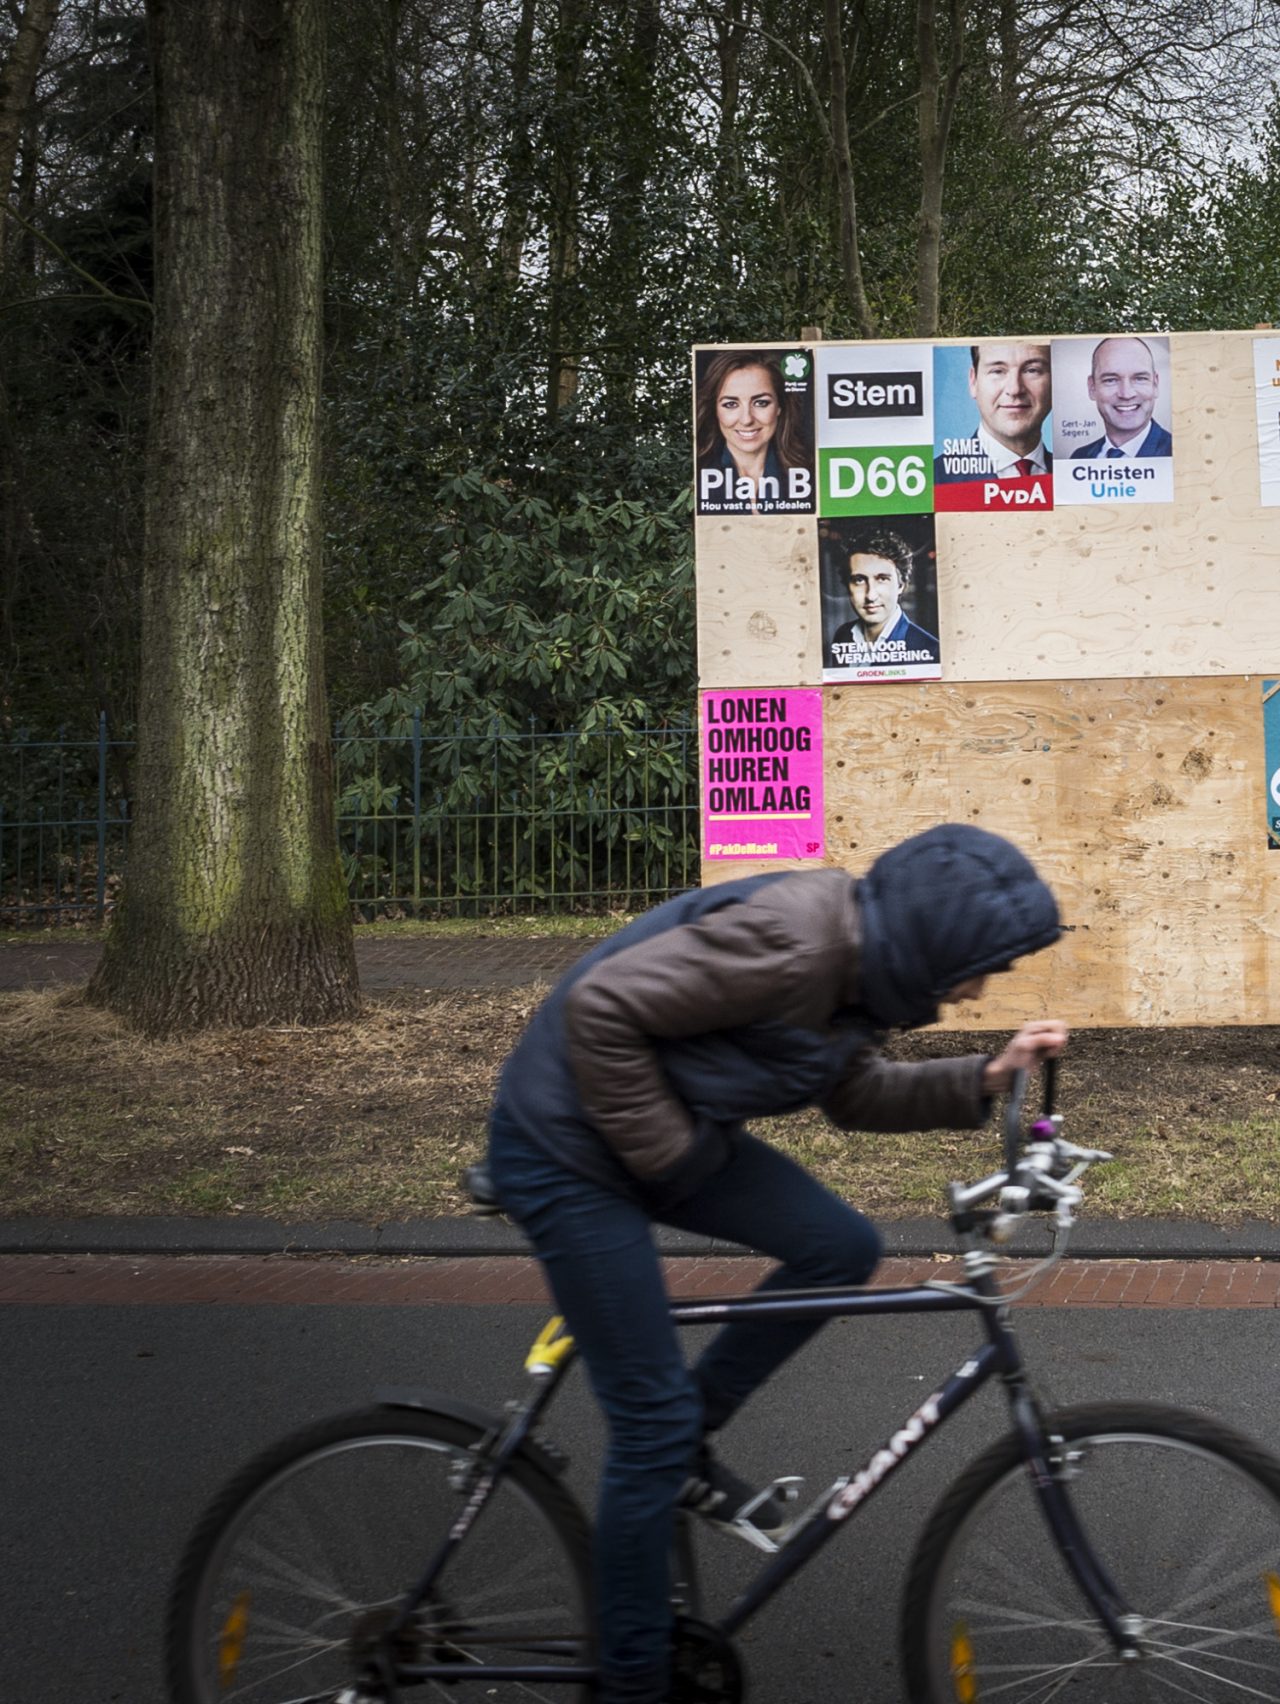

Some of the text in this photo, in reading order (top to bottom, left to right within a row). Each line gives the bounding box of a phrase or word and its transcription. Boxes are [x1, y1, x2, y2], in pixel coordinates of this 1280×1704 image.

[833, 379, 916, 407] Stem
[1062, 420, 1097, 428] Gert-Jan
[1062, 429, 1089, 438] Segers
[943, 438, 989, 456] SAMEN
[943, 456, 999, 475] VOORUIT
[1072, 465, 1155, 481] Christen
[701, 467, 812, 500] Plan B
[829, 455, 927, 498] D66
[1091, 482, 1136, 498] Unie
[701, 500, 812, 511] Hou vast aan je idealen
[831, 640, 907, 654] STEM VOOR
[836, 649, 934, 665] VERANDERING.
[707, 697, 786, 724] LONEN
[708, 726, 811, 753] OMHOOG
[709, 756, 788, 783] HUREN
[709, 785, 811, 812] OMLAAG
[806, 842, 820, 853] SP
